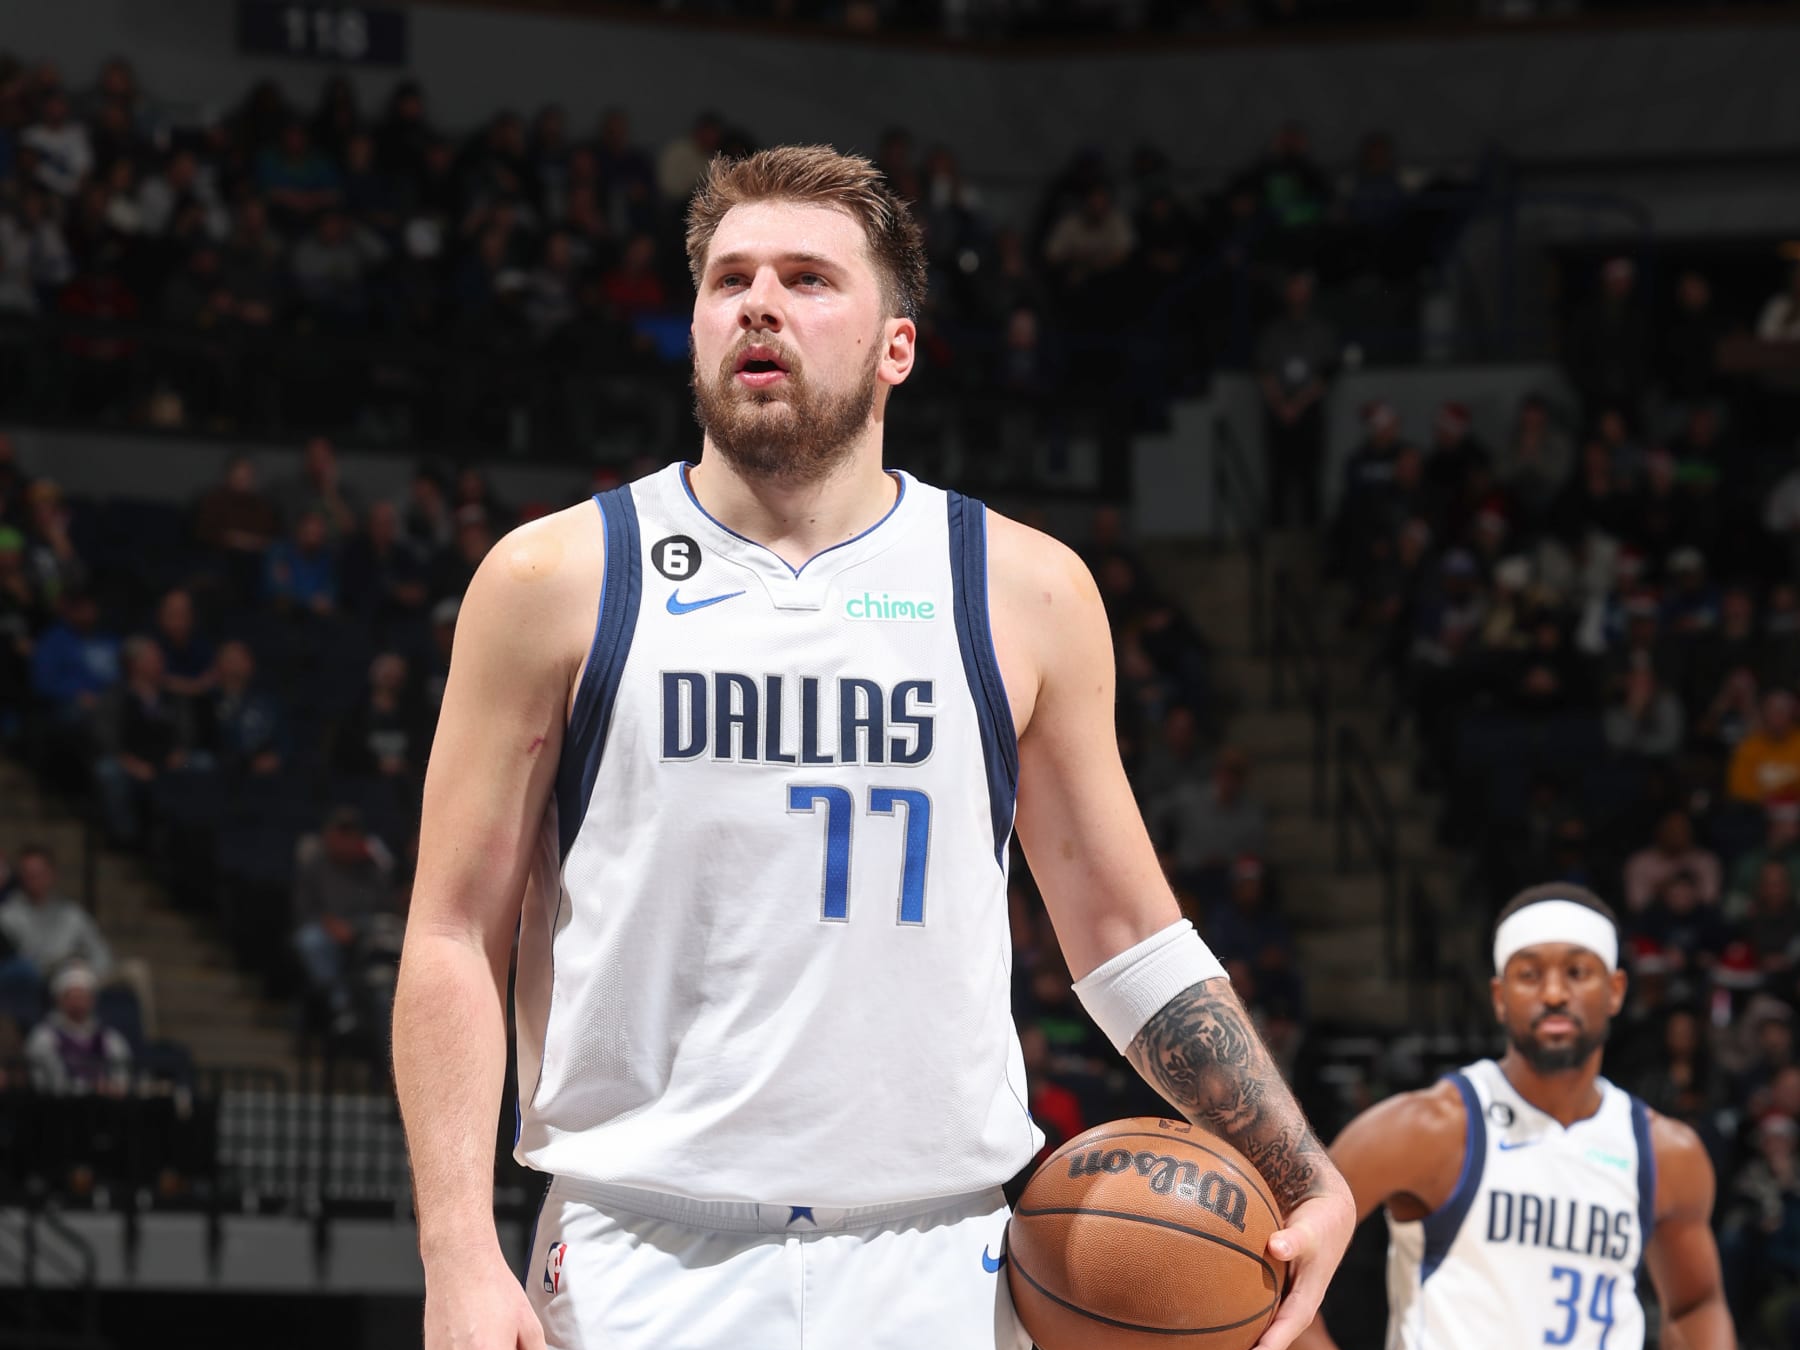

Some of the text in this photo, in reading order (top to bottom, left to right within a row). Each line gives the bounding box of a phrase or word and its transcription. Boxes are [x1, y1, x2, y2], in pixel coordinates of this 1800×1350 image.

[662, 541, 690, 575] 6
[846, 593, 935, 620] chime
[659, 670, 937, 768] DALLAS
[786, 783, 933, 926] 77
[1067, 1148, 1248, 1233] Wilson
[1485, 1189, 1632, 1262] DALLAS
